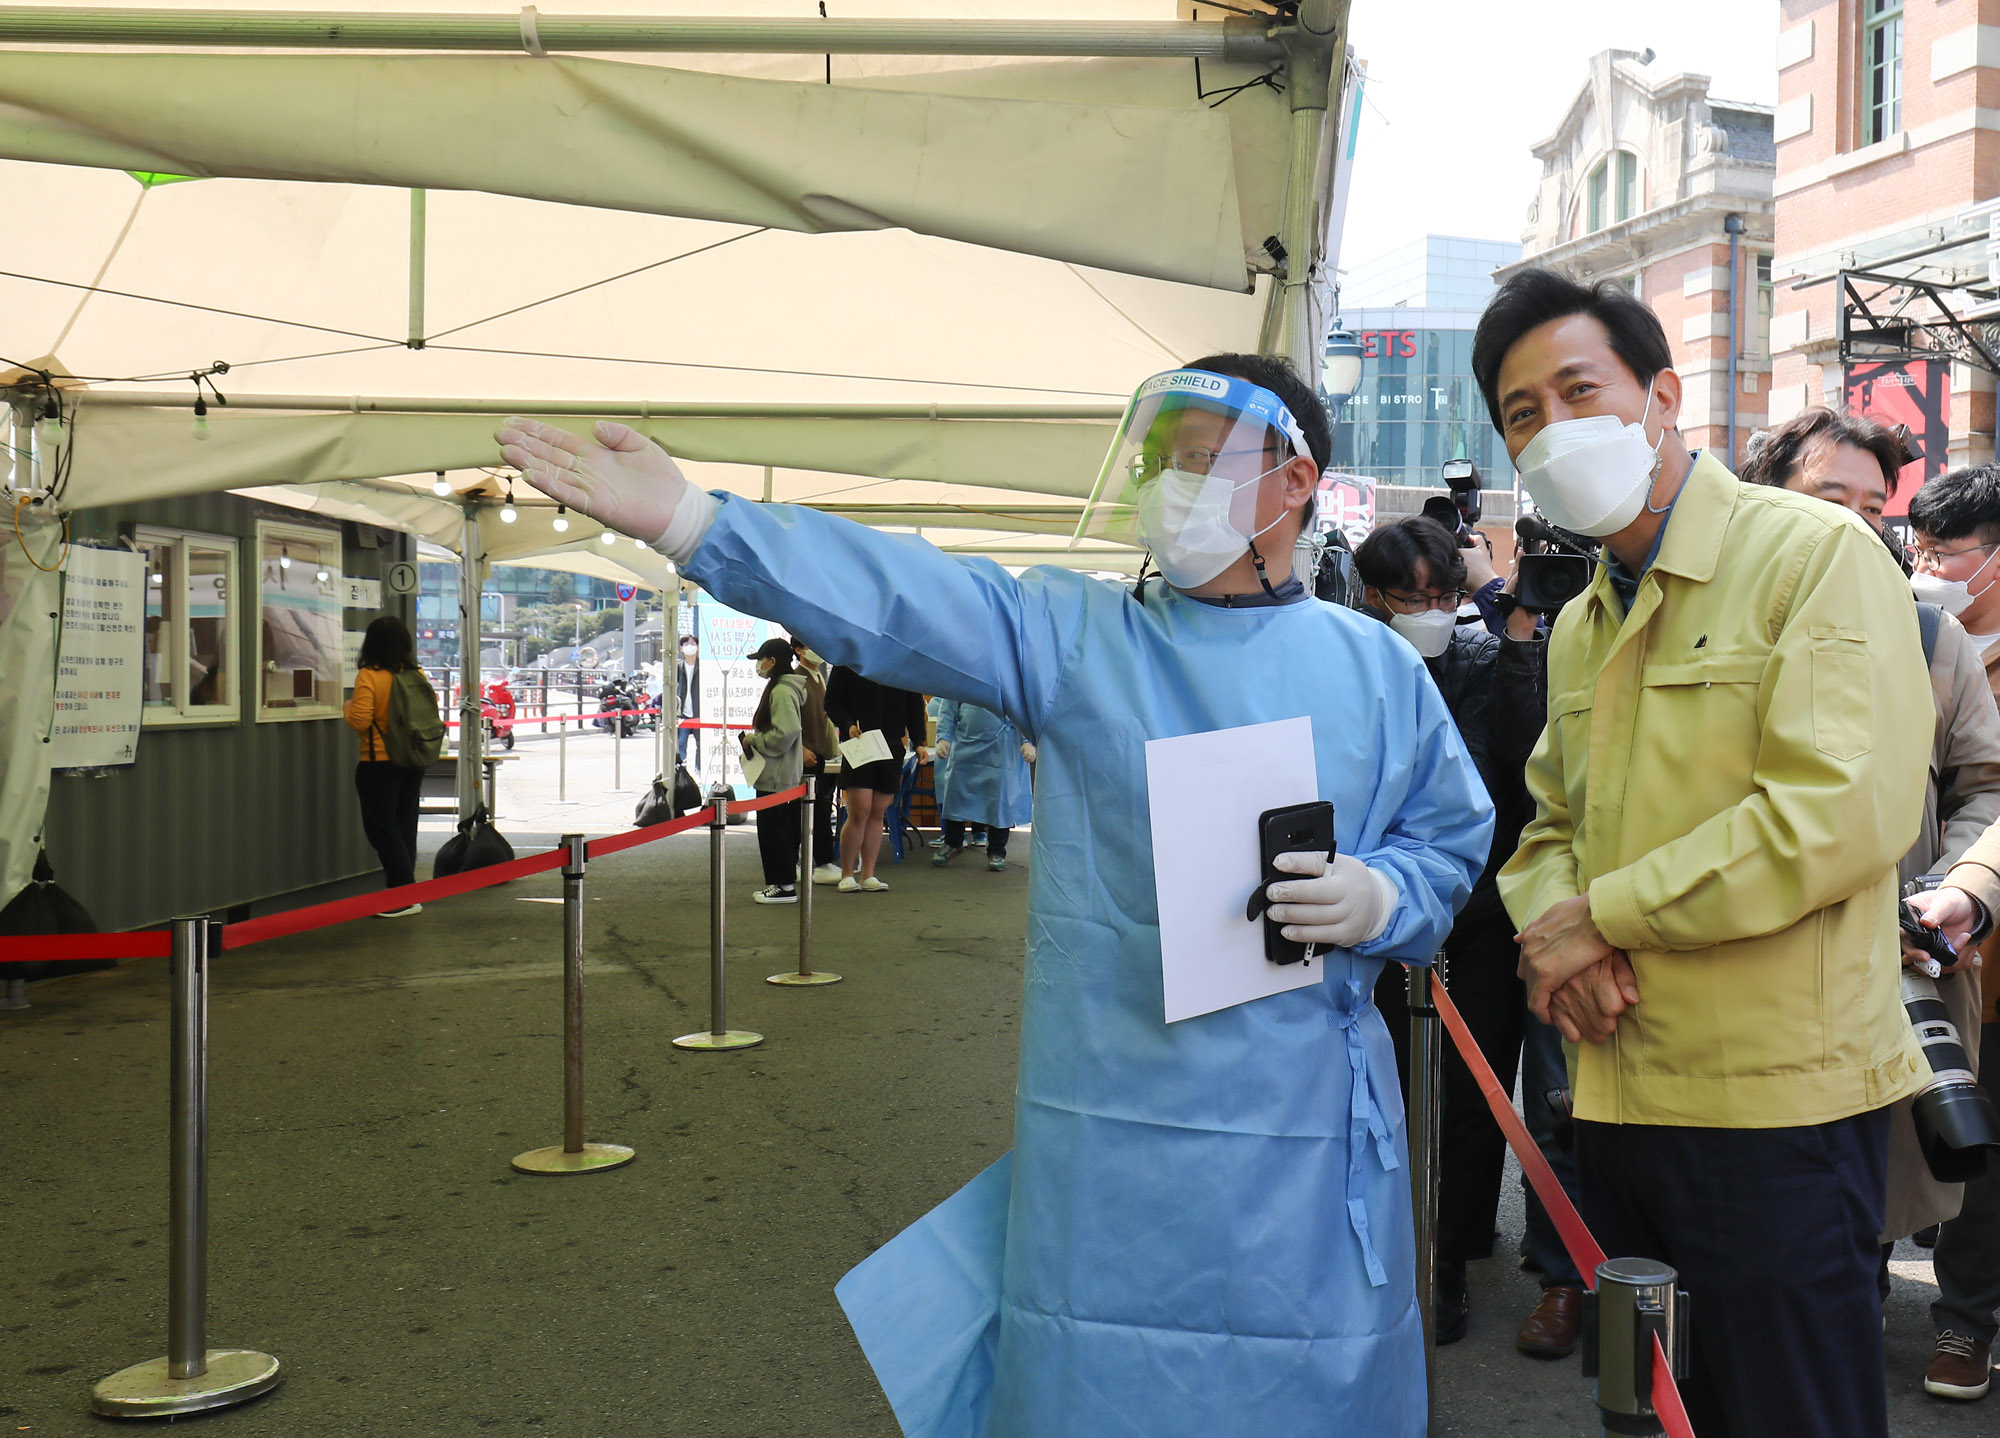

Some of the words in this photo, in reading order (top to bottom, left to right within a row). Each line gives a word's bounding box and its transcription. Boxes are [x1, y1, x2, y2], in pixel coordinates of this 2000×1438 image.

[1142, 376, 1168, 391] FACE
[1170, 375, 1221, 391] SHIELD
[1380, 395, 1422, 404] BISTRO
